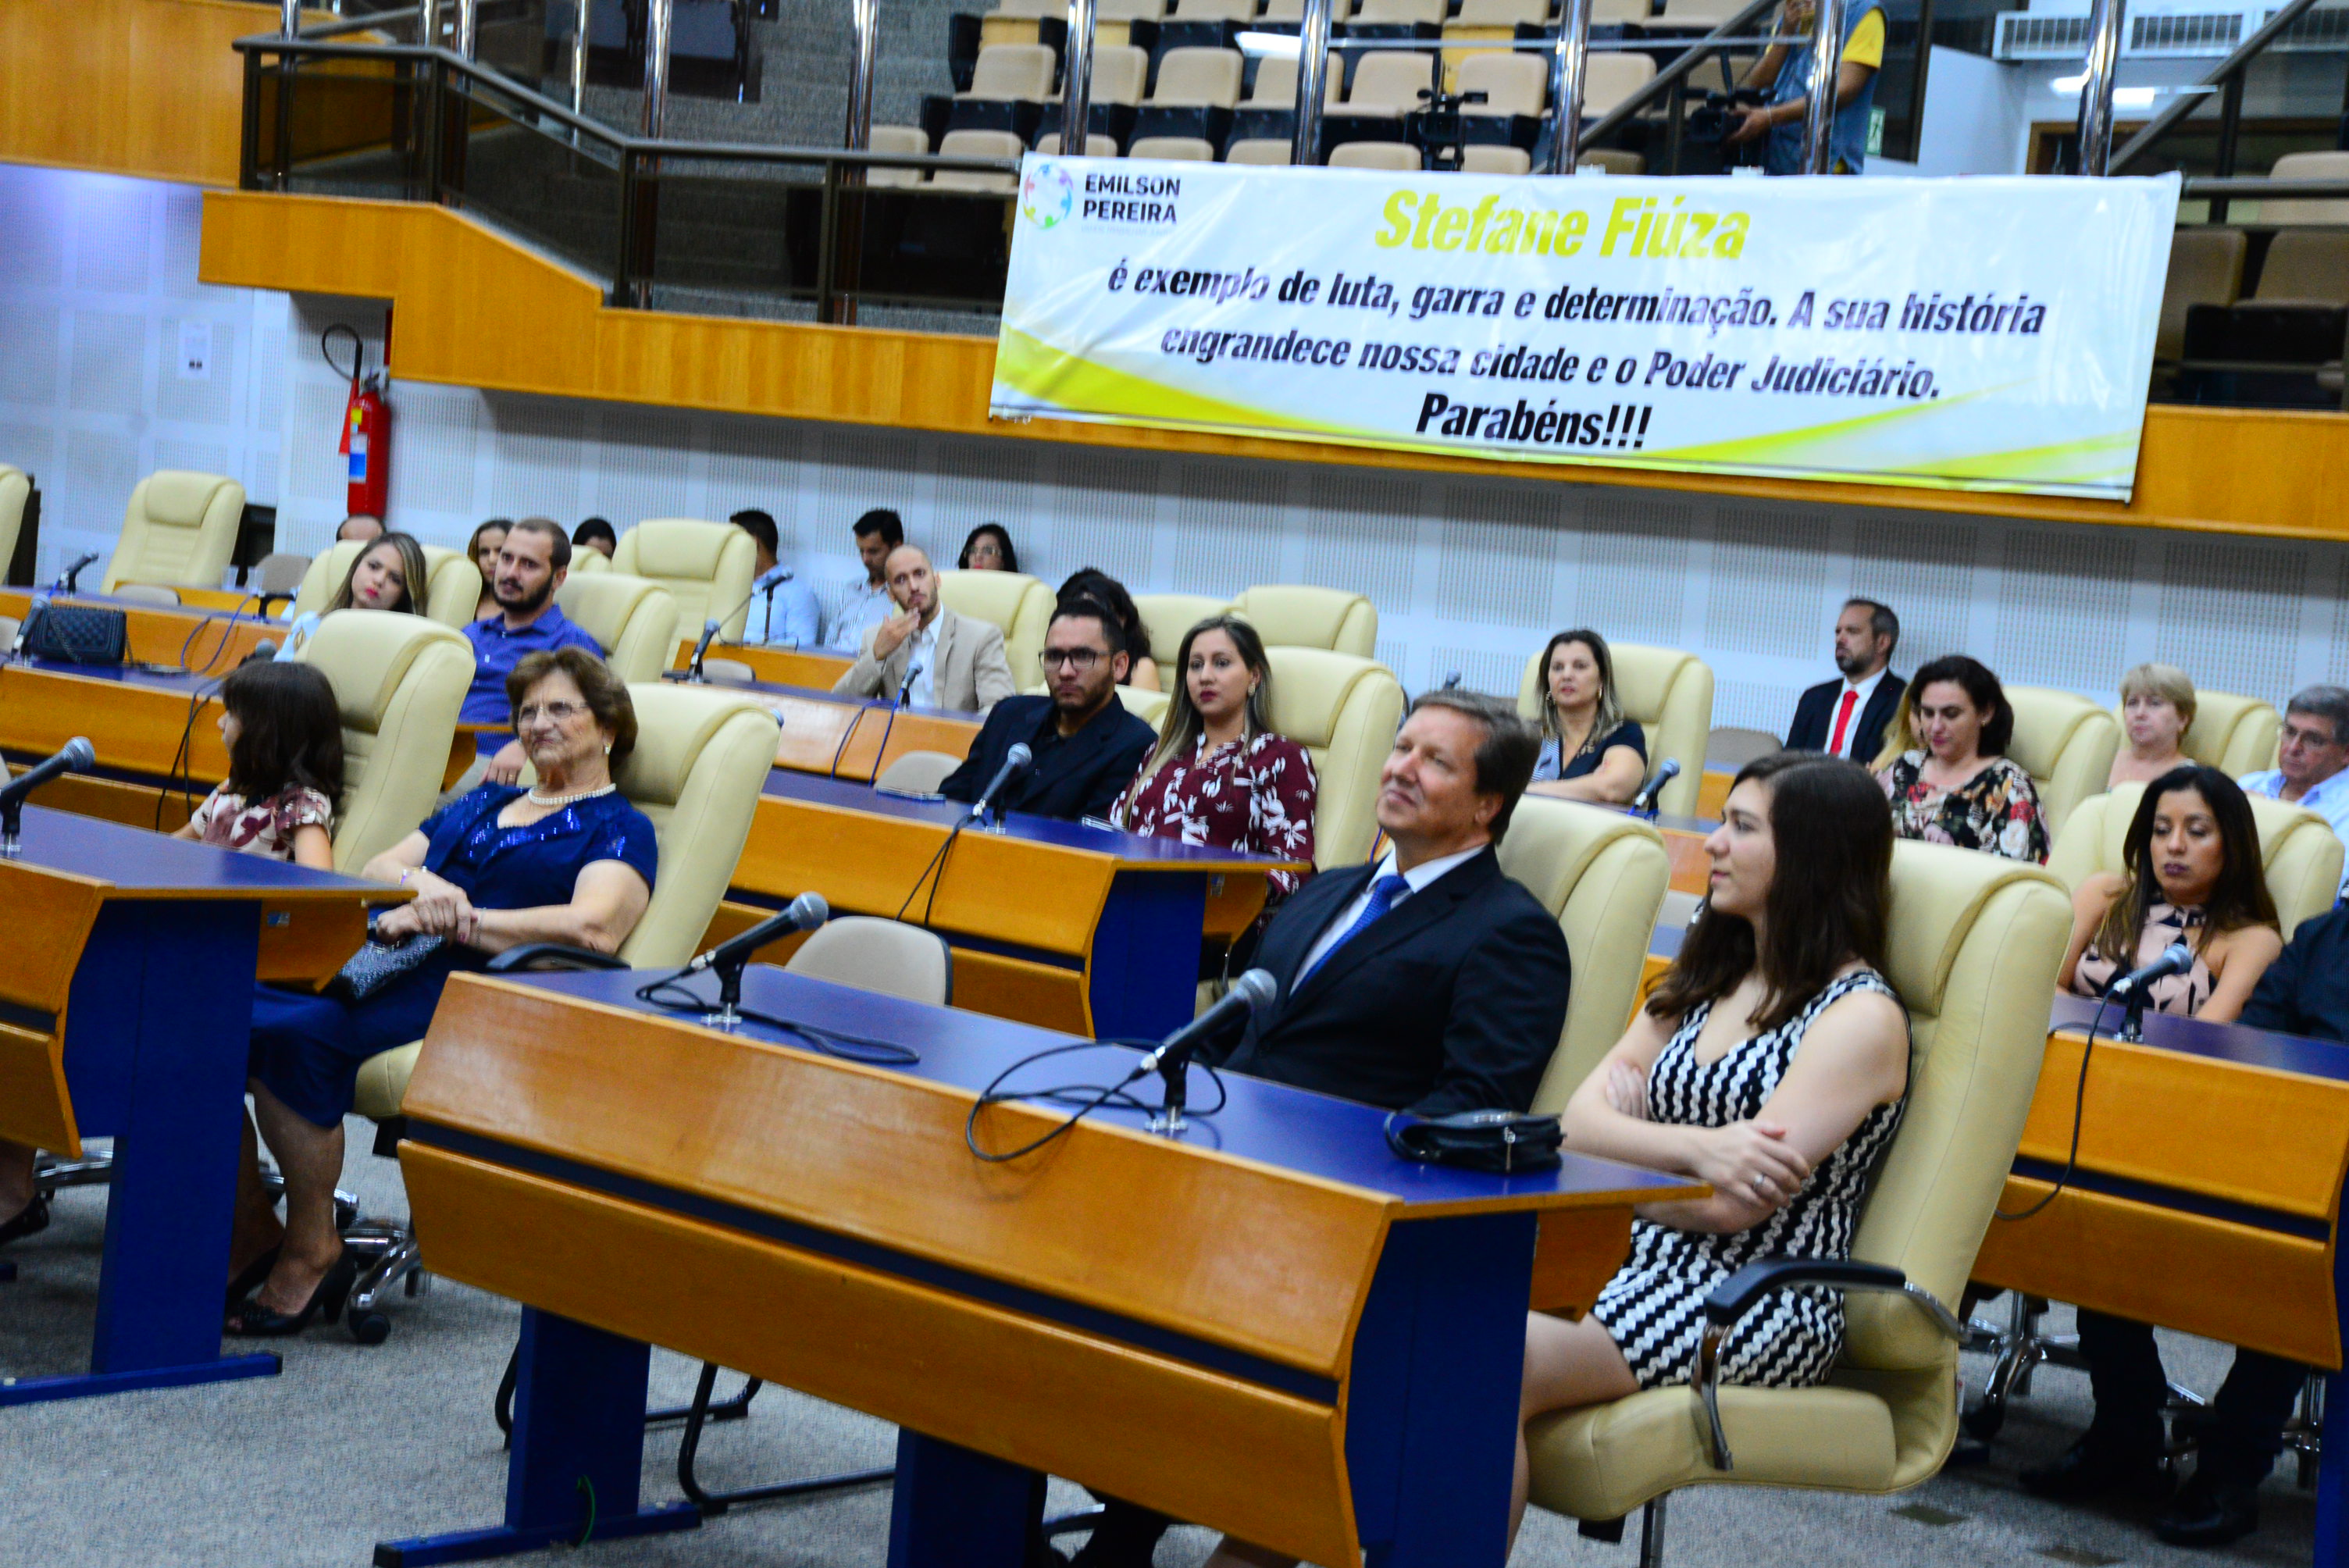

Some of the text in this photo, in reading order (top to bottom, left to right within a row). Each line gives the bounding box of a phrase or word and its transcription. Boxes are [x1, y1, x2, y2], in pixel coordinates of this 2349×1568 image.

[1082, 198, 1178, 225] PEREIRA
[1085, 173, 1181, 198] EMILSON
[1376, 190, 1750, 258] Stefane Fiúza
[1108, 257, 2047, 336] é exemplo de luta, garra e determinação. A sua história
[1160, 326, 1940, 399] engrandece nossa cidade e o Poder Judiciário.
[1417, 392, 1652, 449] Parabéns!!!
